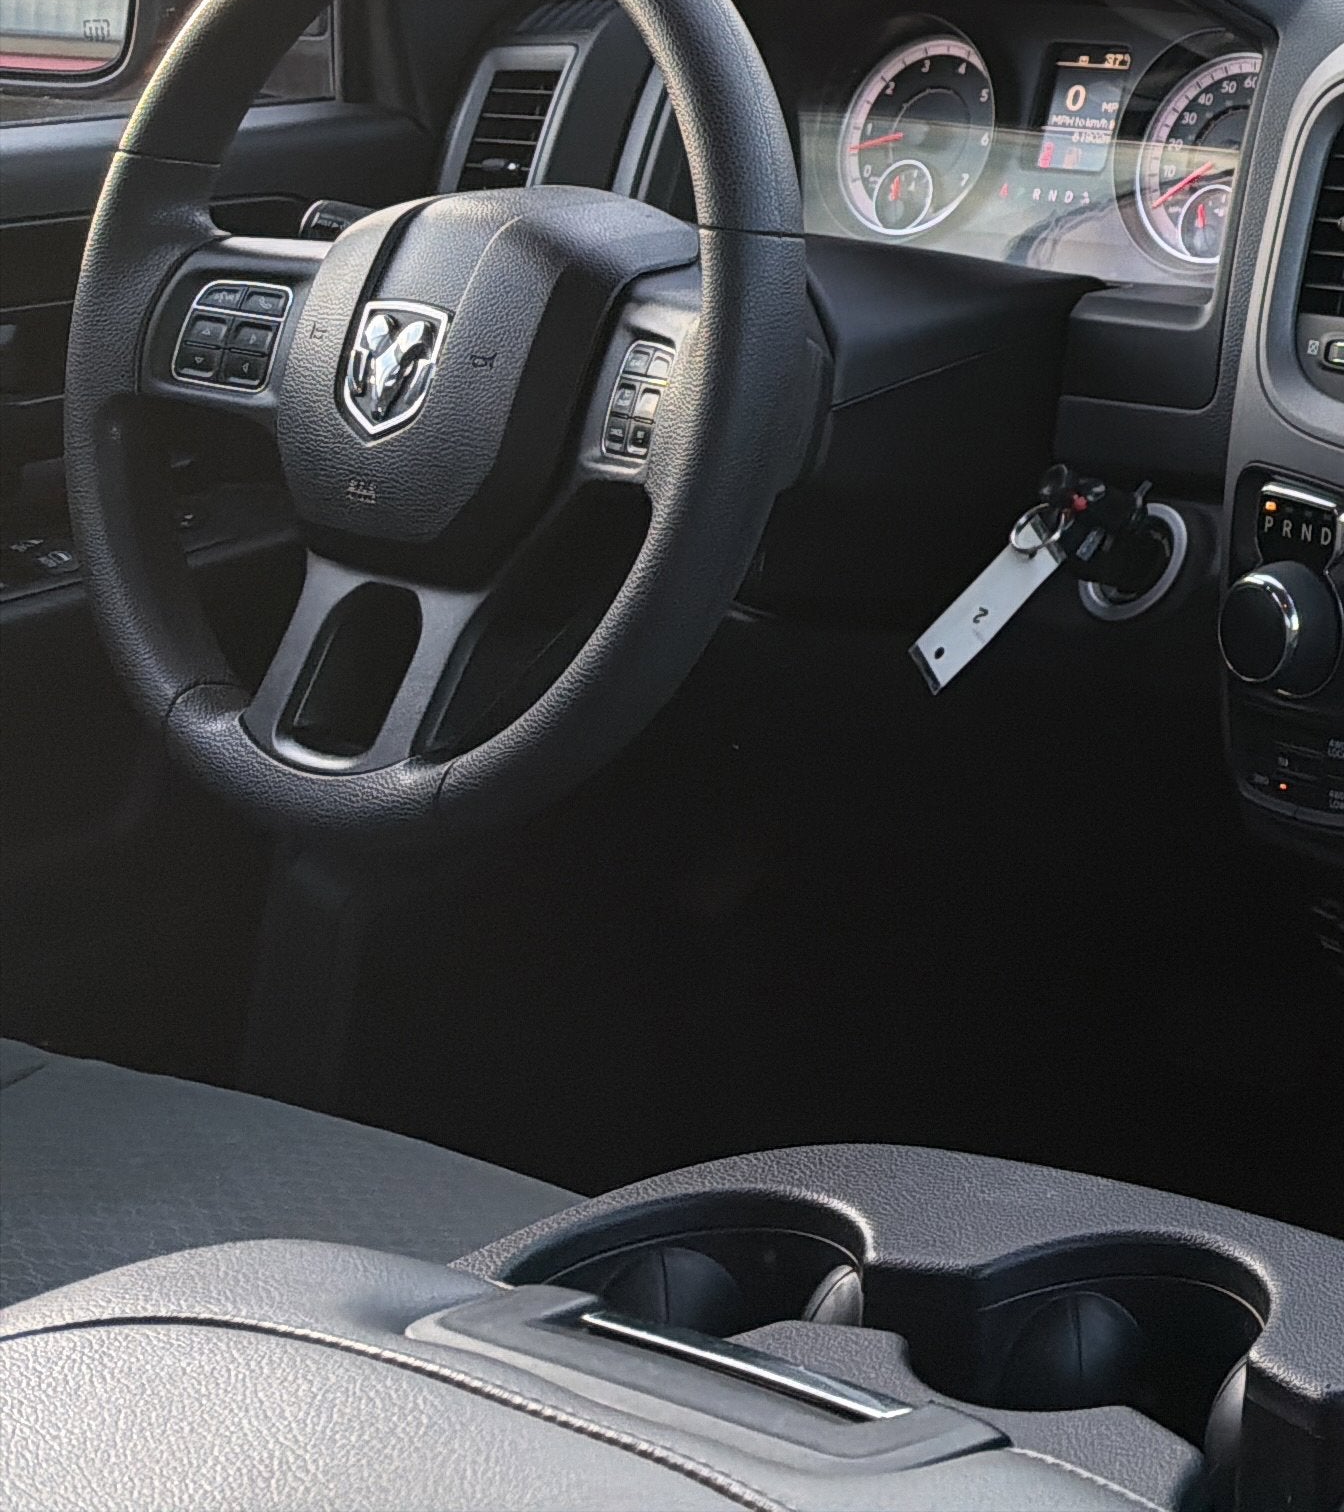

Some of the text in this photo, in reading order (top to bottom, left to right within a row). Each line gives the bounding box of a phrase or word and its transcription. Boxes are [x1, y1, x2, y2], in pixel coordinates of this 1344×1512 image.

[921, 59, 931, 73] 3
[957, 62, 967, 75] 4
[885, 81, 896, 95] 2
[1220, 80, 1237, 93] 50
[980, 89, 990, 102] 5
[1066, 84, 1119, 113] 0 MP
[1198, 93, 1214, 106] 40
[1181, 112, 1197, 125] 30
[866, 123, 873, 135] 1
[981, 132, 990, 146] 6
[1168, 139, 1184, 150] 20
[863, 164, 872, 178] 0
[1163, 165, 1177, 177] 10
[960, 173, 970, 186] 7
[1032, 188, 1041, 200] R
[1048, 189, 1057, 202] N
[1064, 190, 1073, 203] D
[1263, 516, 1332, 546] P R N D
